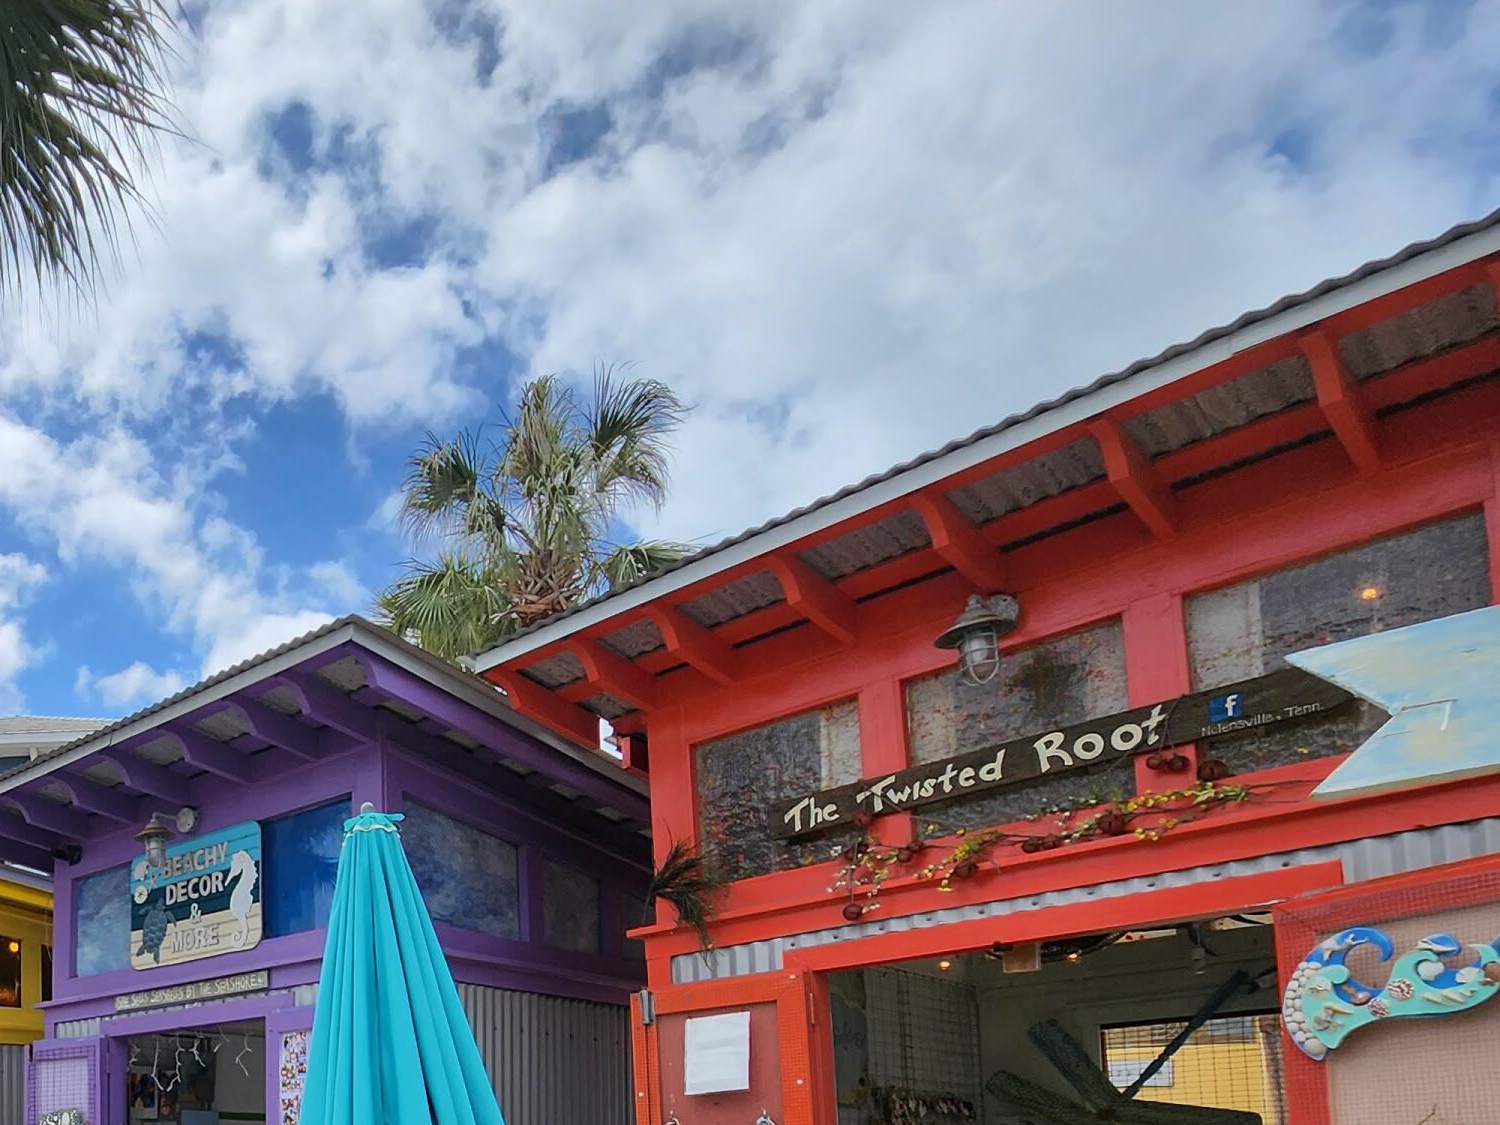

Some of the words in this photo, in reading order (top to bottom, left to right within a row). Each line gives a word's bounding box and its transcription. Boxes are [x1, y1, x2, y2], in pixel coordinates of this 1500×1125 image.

[1283, 702, 1325, 718] Tenn.
[784, 796, 840, 832] The
[856, 748, 1007, 814] Twisted
[1033, 704, 1166, 774] Root
[163, 841, 229, 879] BEACHY
[165, 871, 224, 906] DECOR
[190, 902, 202, 924] &
[171, 924, 221, 954] MORE
